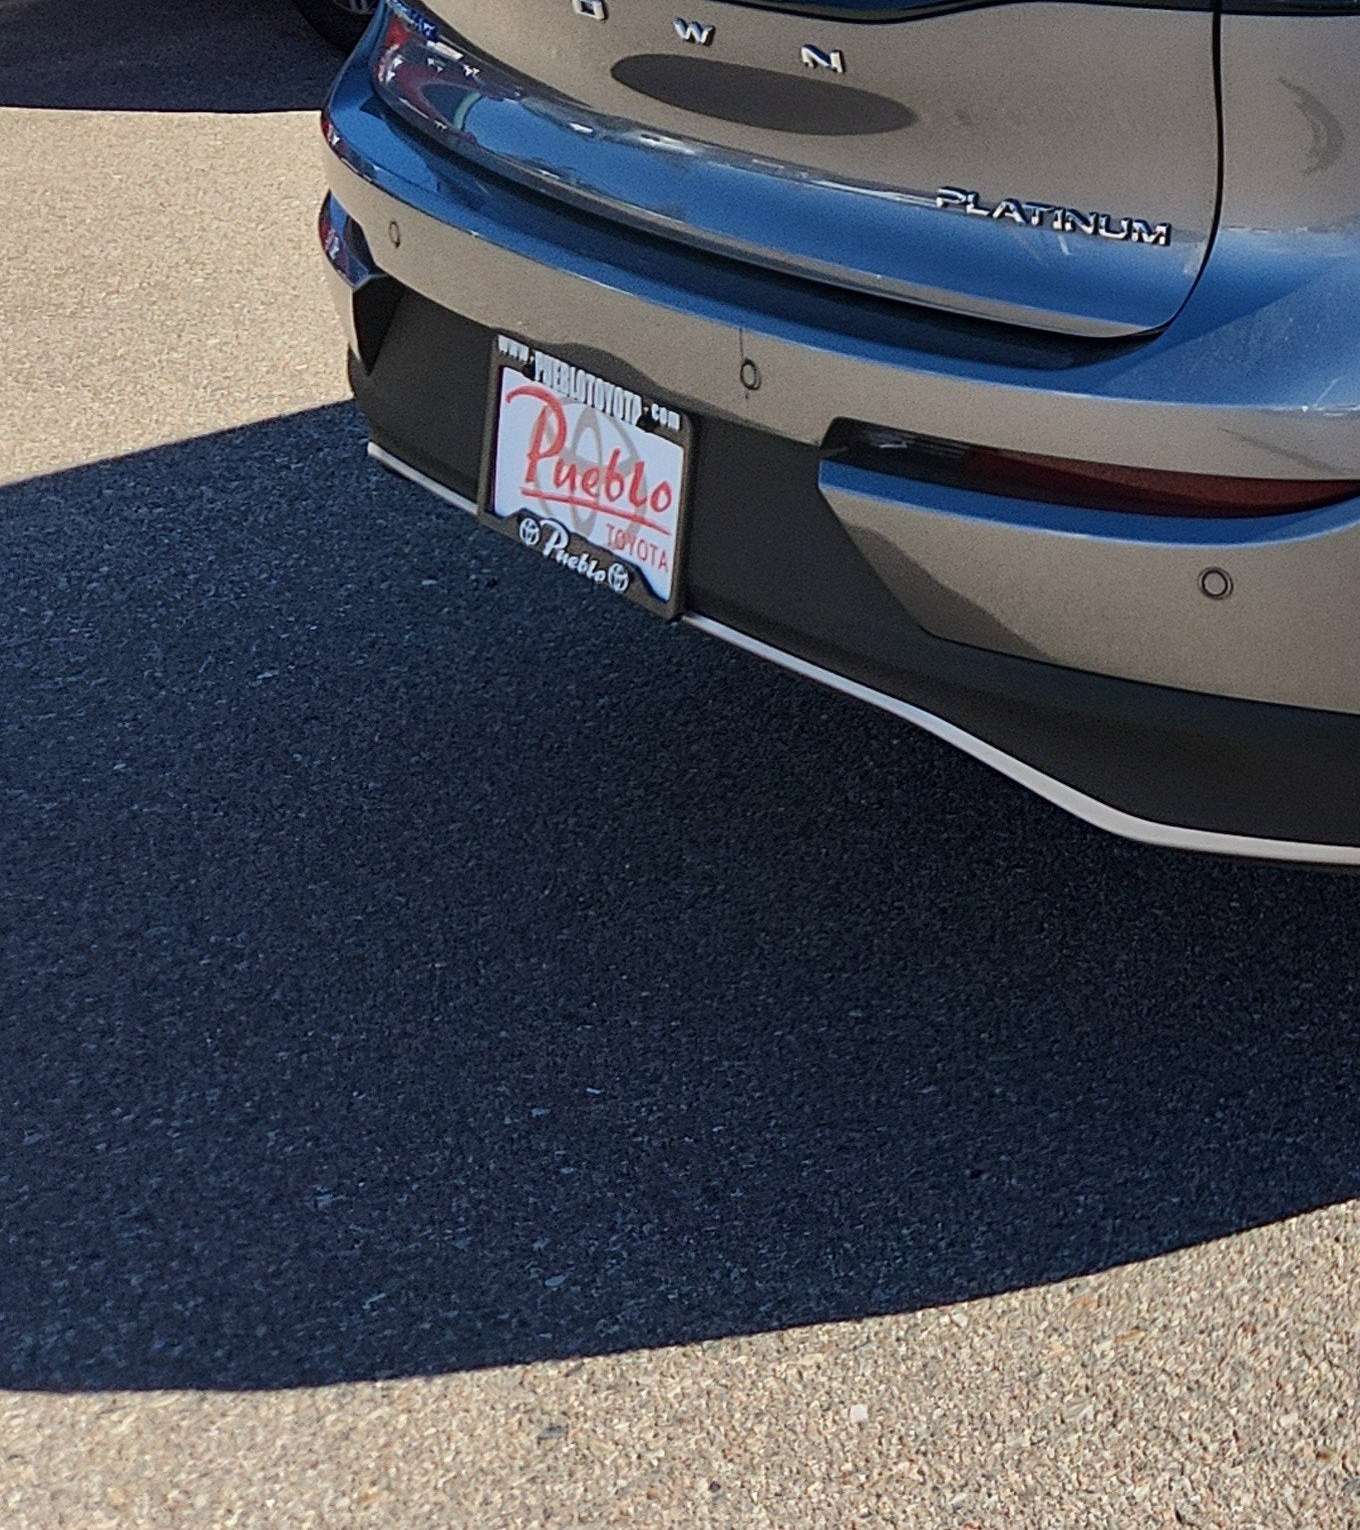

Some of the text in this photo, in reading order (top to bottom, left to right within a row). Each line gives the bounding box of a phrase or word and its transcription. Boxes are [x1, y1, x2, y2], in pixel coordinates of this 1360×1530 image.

[936, 185, 1172, 247] PLATINUM
[505, 384, 673, 513] Pueblo
[540, 518, 606, 583] Pueblo
[605, 522, 669, 574] TOYOTA
